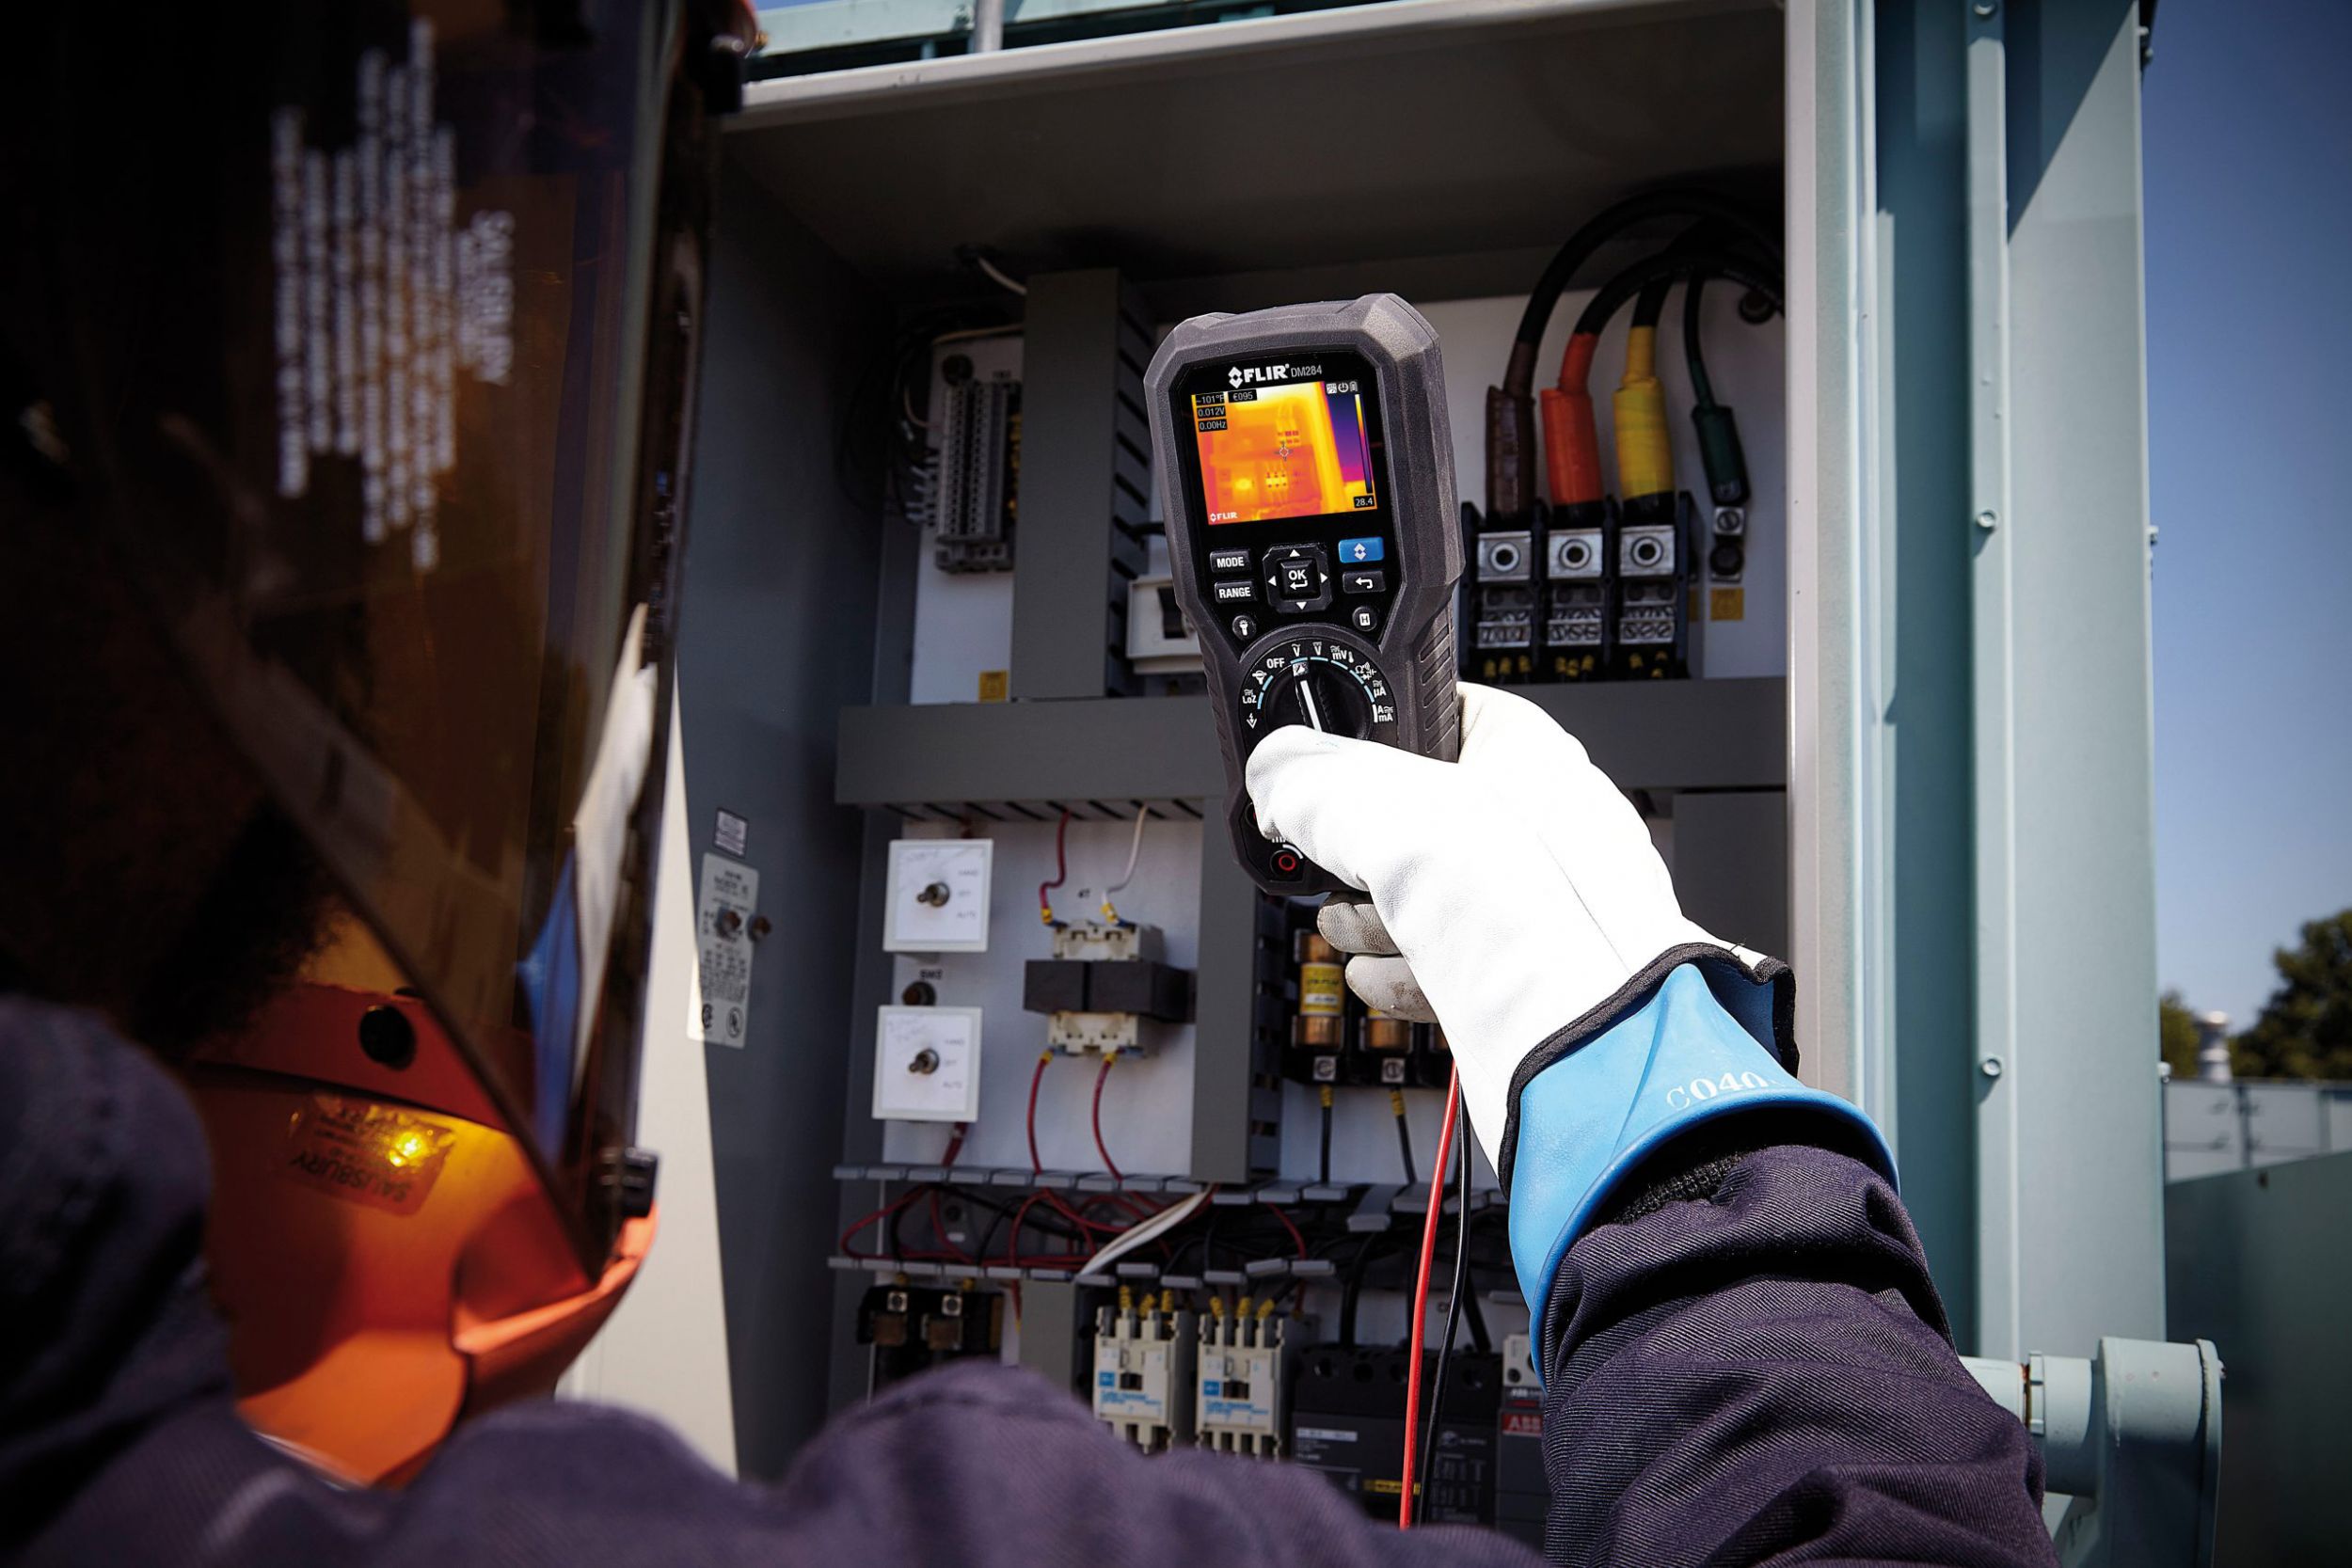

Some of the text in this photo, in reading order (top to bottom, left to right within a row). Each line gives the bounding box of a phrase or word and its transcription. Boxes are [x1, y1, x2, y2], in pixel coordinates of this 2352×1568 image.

[1291, 365, 1323, 378] DM284
[1198, 406, 1225, 417] 0.012V
[1199, 420, 1227, 431] 0.00Hz
[1355, 497, 1374, 507] 28.4
[1216, 512, 1238, 521] FLIR
[1216, 556, 1245, 568] MODE
[1288, 569, 1308, 581] OK
[1218, 586, 1251, 599] RANGE
[1332, 650, 1348, 660] mV
[1266, 657, 1285, 669] OFF
[1242, 694, 1258, 705] LoZ
[1378, 712, 1393, 722] mA
[1666, 1070, 1785, 1111] C040
[1508, 1415, 1542, 1432] ABB
